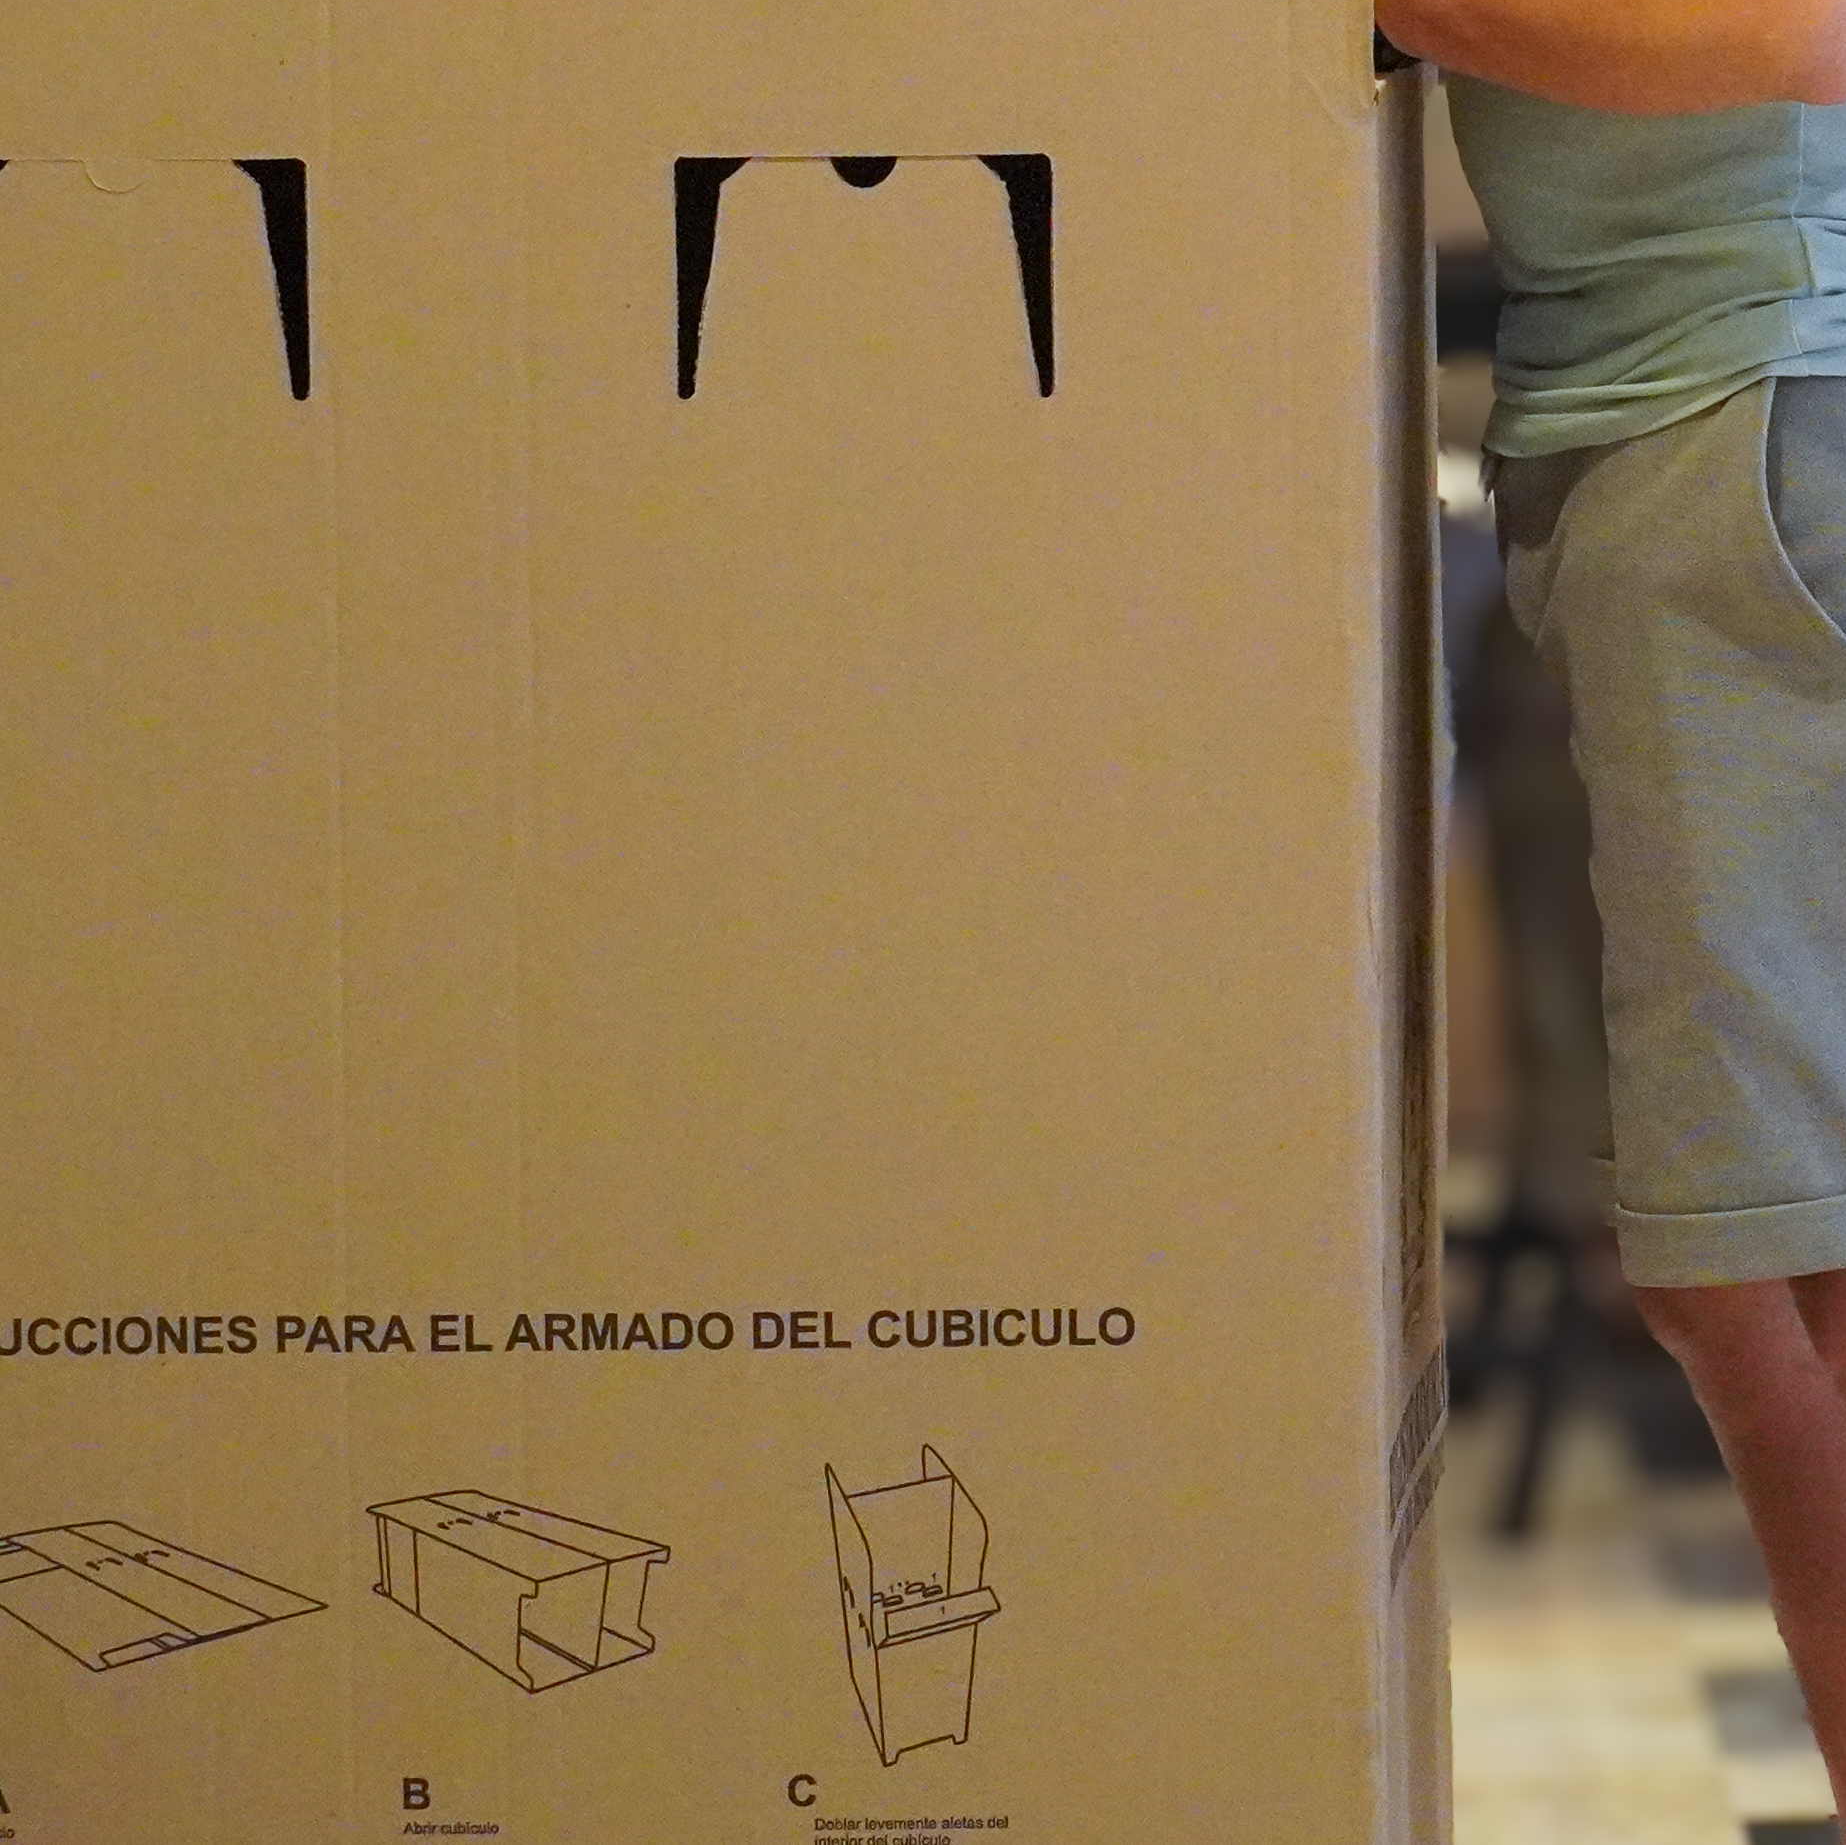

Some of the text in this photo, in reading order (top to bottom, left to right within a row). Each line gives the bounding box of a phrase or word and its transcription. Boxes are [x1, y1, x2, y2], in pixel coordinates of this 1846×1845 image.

[0, 1307, 1135, 1356] UCCIONES PARA EL ARMADO DEL CUBICULO
[403, 1778, 430, 1810] B
[788, 1774, 817, 1807] C
[403, 1821, 437, 1835] Abrir
[987, 1815, 1009, 1830] del
